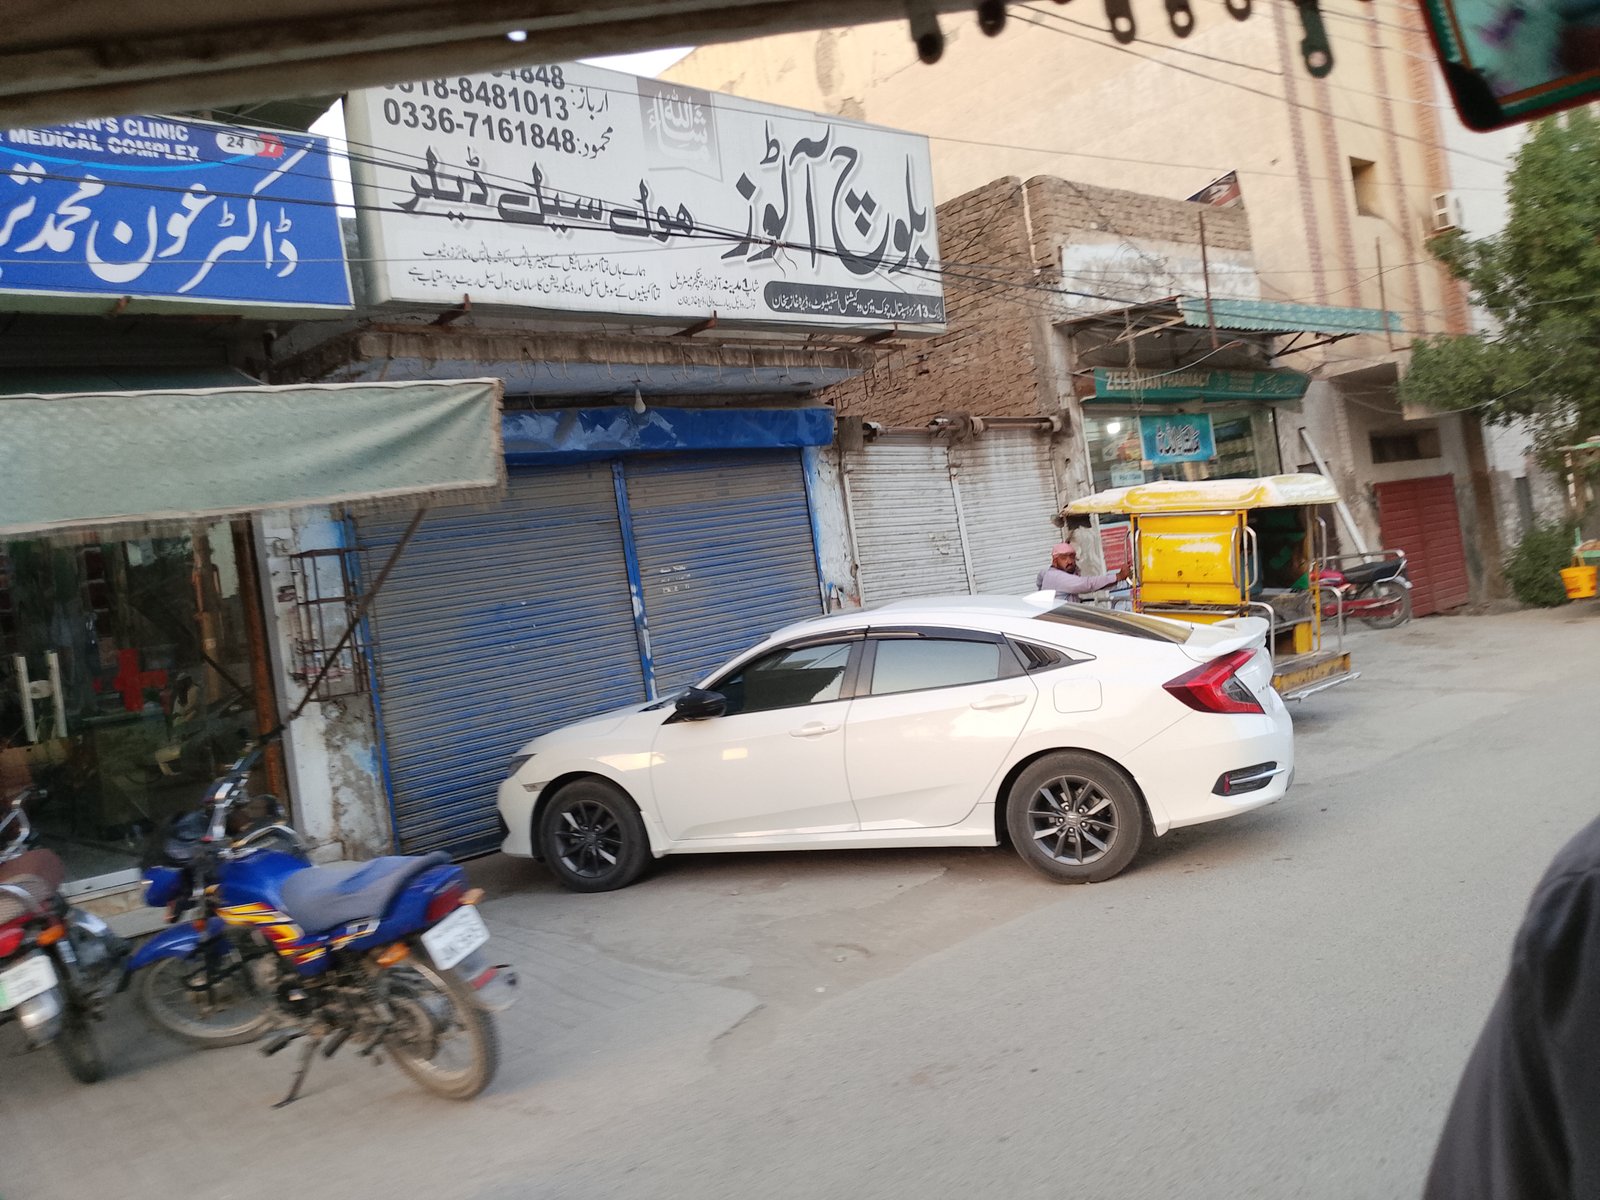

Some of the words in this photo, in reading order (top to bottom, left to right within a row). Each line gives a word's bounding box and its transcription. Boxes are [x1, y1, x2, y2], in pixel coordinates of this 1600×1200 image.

[9, 128, 104, 152] MEDICAL
[107, 137, 201, 162] COMPLEX
[123, 118, 188, 142] CLINIC
[383, 97, 576, 155] 0336-7161848
[14, 174, 105, 254] محمد
[177, 139, 315, 294] ڈاکٹر
[392, 145, 489, 222] ڈیلر
[497, 162, 602, 233] سیل
[720, 119, 831, 269] آٹوز
[830, 146, 930, 276] بلوچ
[86, 183, 217, 283] عون
[917, 303, 928, 318] 13
